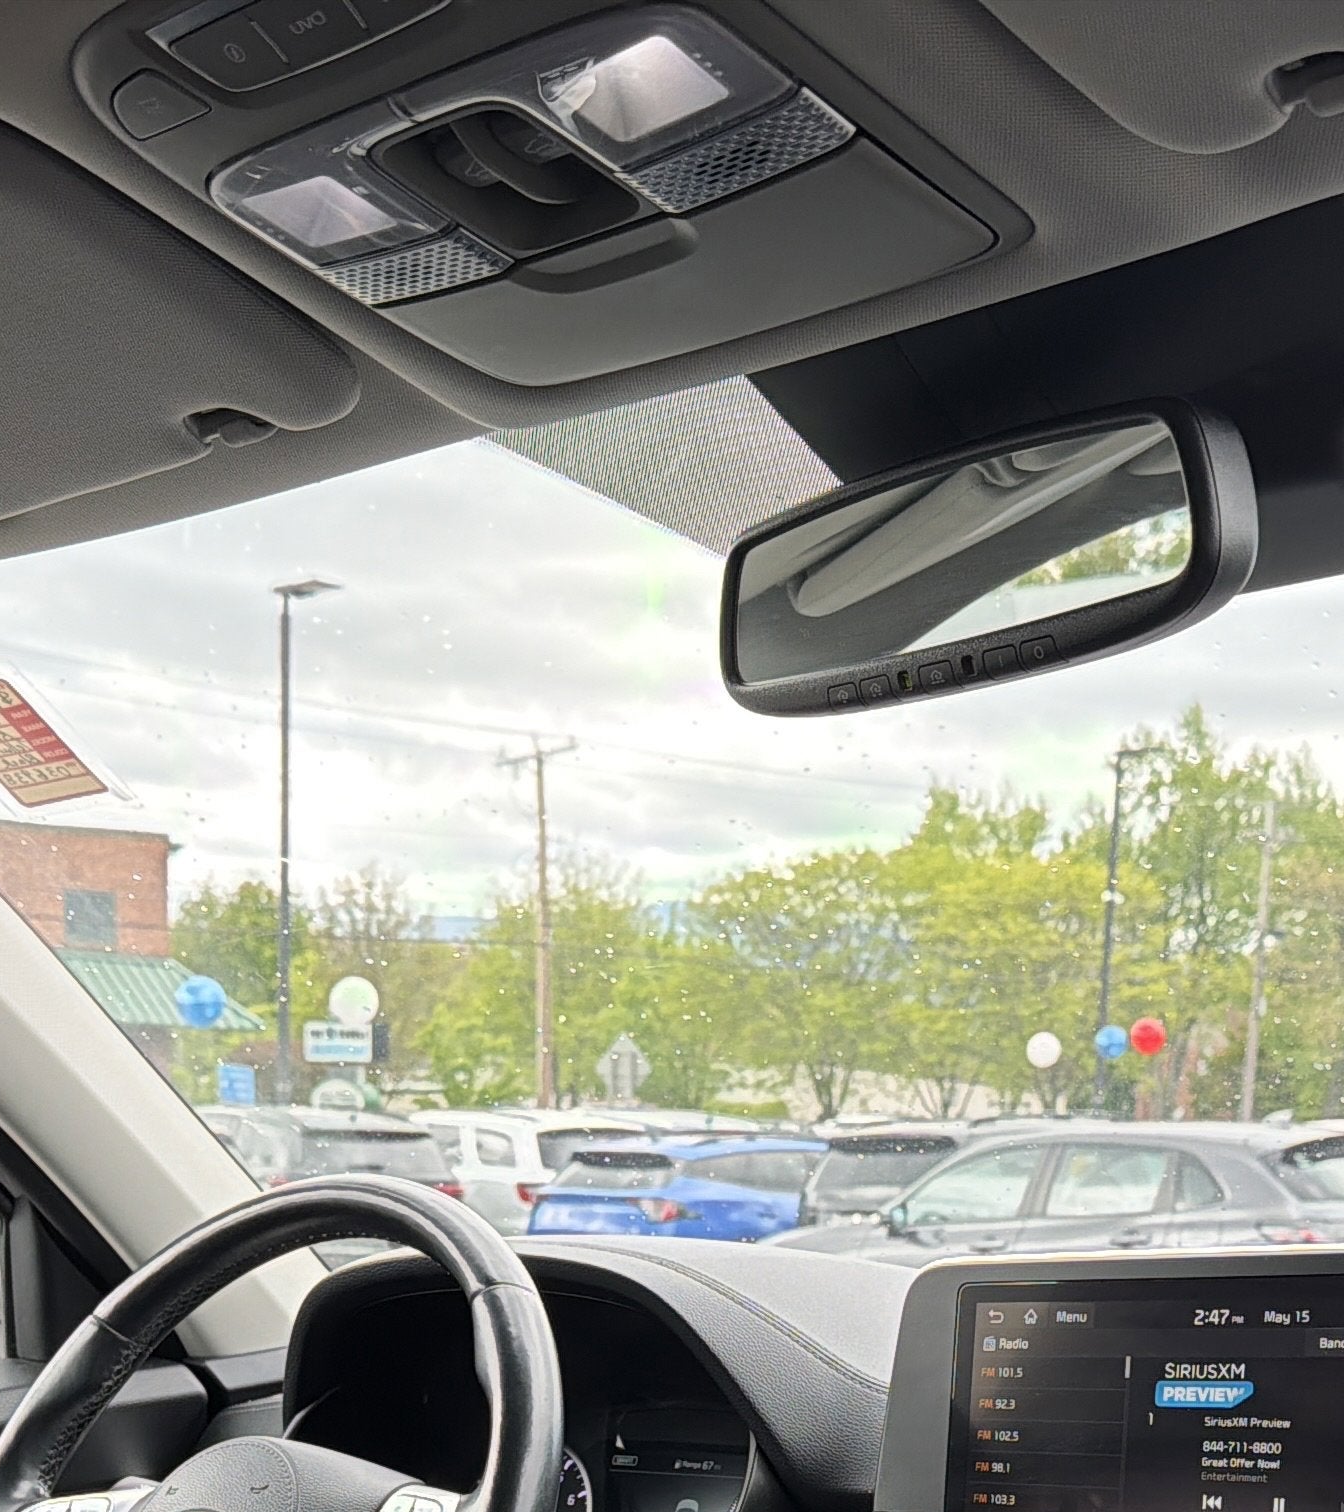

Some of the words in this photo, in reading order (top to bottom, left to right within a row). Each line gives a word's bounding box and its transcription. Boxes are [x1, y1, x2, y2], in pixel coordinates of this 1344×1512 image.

[288, 10, 327, 35] UVO
[1056, 1310, 1087, 1323] Menu
[1194, 1308, 1230, 1326] 2:47
[1263, 1310, 1291, 1325] May
[1295, 1310, 1310, 1323] 15
[998, 1337, 1029, 1350] Radio
[981, 1367, 995, 1377] FM
[998, 1367, 1024, 1378] 101.5
[1162, 1386, 1246, 1402] PREVIEW
[979, 1399, 993, 1409] FM
[994, 1399, 1016, 1410] 92.3
[1204, 1416, 1248, 1427] SiriusXM
[1250, 1417, 1291, 1429] Preview
[977, 1430, 991, 1441] FM
[994, 1430, 1019, 1442] 102.5
[1202, 1440, 1282, 1455] 844-711-8800
[702, 1460, 714, 1471] 67
[975, 1462, 989, 1472] FM
[991, 1462, 1010, 1474] 98.1
[1201, 1457, 1228, 1468] Great
[1230, 1457, 1255, 1469] Offer
[1257, 1458, 1280, 1470] Now!
[1201, 1471, 1268, 1483] Entertainment
[567, 1494, 576, 1506] 6
[973, 1493, 987, 1504] FM
[991, 1494, 1016, 1506] 103.3
